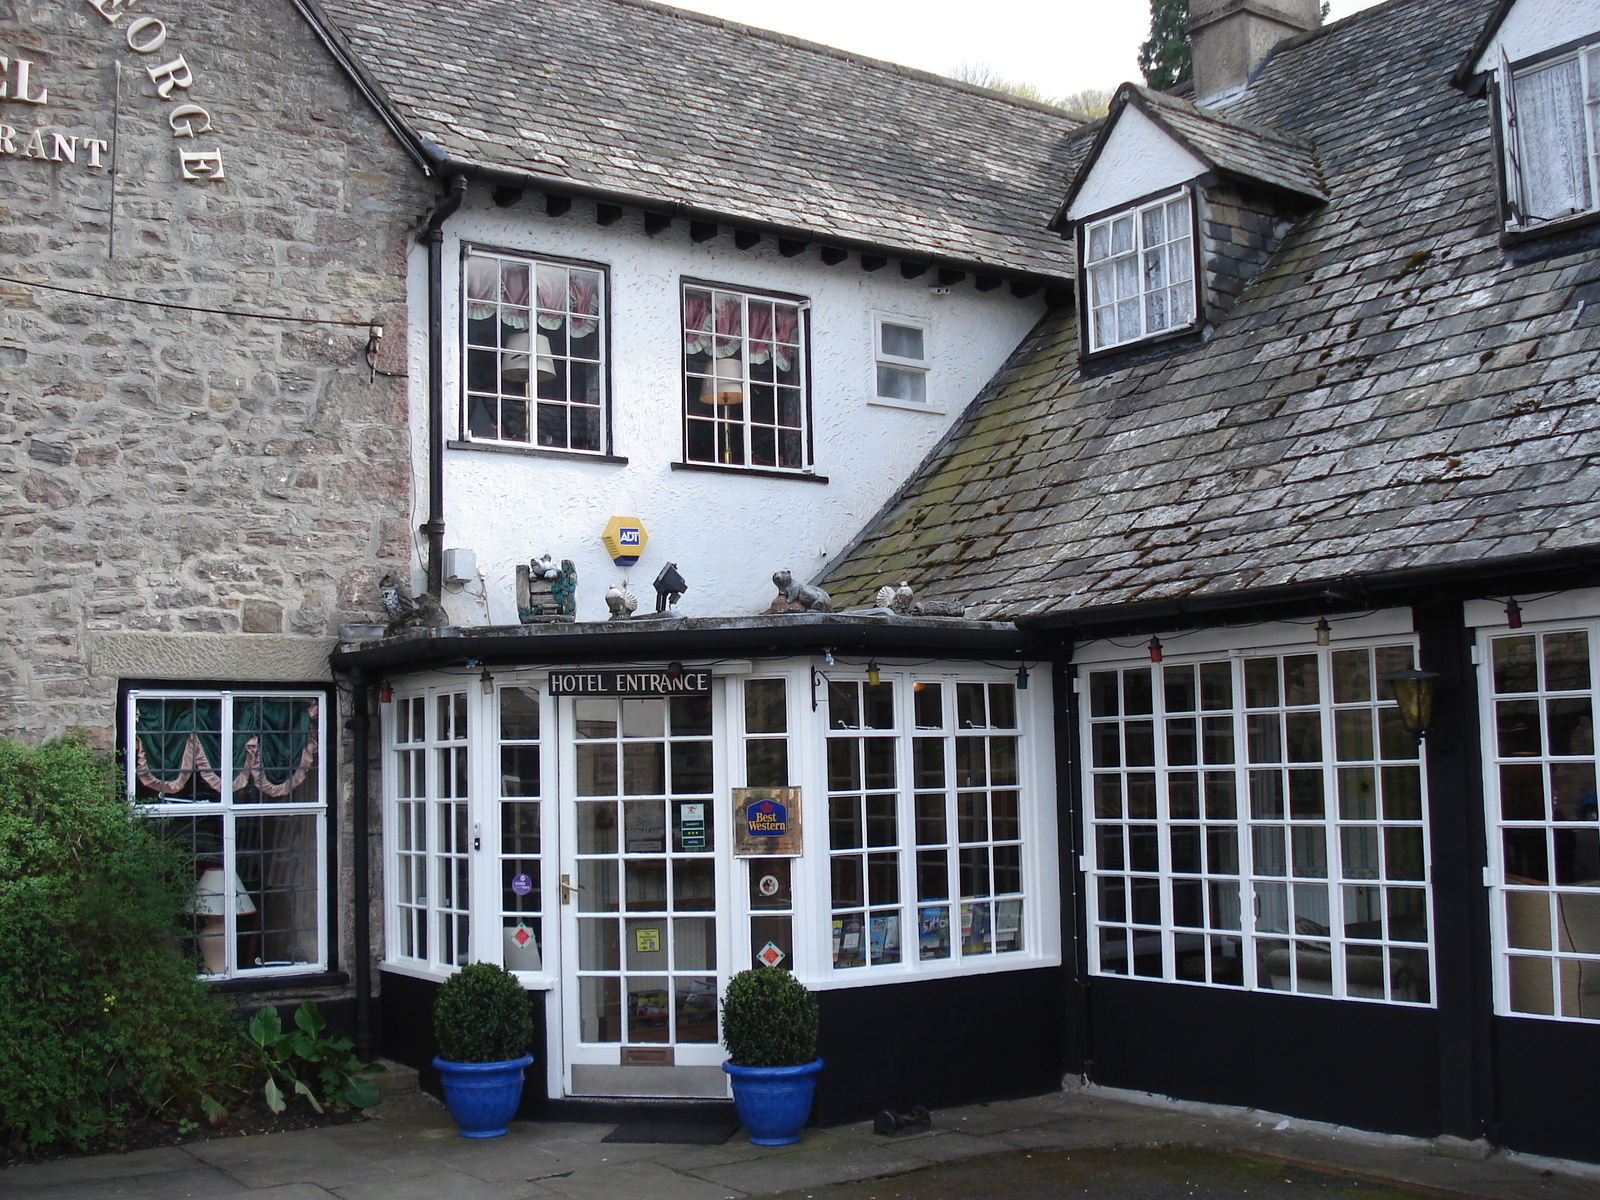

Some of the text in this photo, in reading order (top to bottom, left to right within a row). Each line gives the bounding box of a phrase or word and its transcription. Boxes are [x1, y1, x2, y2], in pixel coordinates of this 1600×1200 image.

[0, 56, 48, 105] L
[620, 531, 639, 542] ADT
[551, 673, 708, 693] HOTEL ENTRANCE
[755, 812, 777, 823] Best
[748, 821, 786, 833] Western
